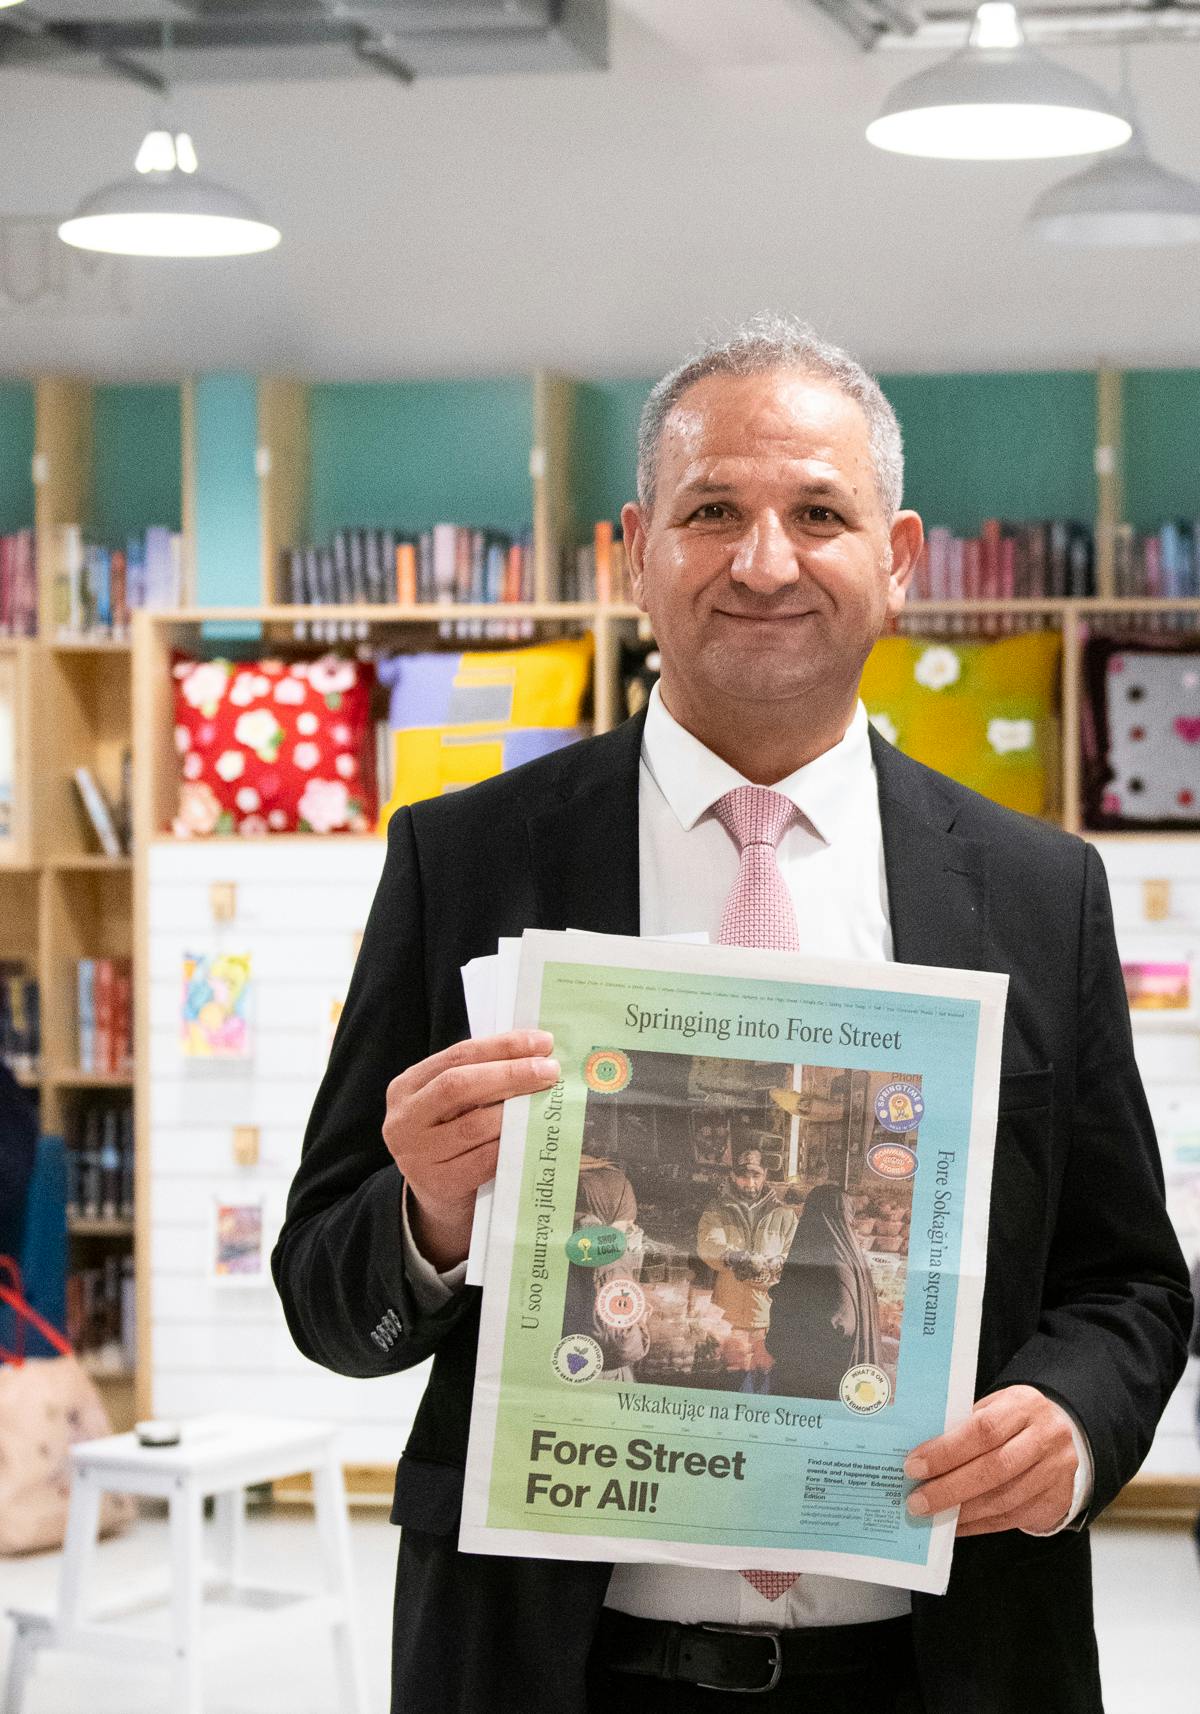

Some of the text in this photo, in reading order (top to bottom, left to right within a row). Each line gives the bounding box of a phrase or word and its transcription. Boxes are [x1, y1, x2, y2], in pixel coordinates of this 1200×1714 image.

[625, 1003, 902, 1050] Springing into Fore Street
[877, 1084, 921, 1107] SPRINGTIME
[874, 1148, 914, 1164] COMMUNITY
[935, 1149, 955, 1186] Fore
[520, 1079, 565, 1330] U soo guuraya jidka Fore Street
[597, 1233, 616, 1245] SHOP
[597, 1245, 620, 1256] LOCAL
[577, 1335, 594, 1346] PHOTO
[876, 1374, 884, 1383] ON
[617, 1392, 823, 1430] Wskakując na Fore Street
[848, 1400, 882, 1412] EDMONTON
[530, 1429, 747, 1481] Fore Street
[808, 1458, 822, 1466] Find
[834, 1460, 851, 1468] about
[863, 1463, 881, 1471] latest
[843, 1470, 880, 1480] happenings
[805, 1485, 826, 1493] Spring
[823, 1477, 844, 1485] Street,
[870, 1481, 903, 1489] Edmonton
[525, 1472, 660, 1514] For All!
